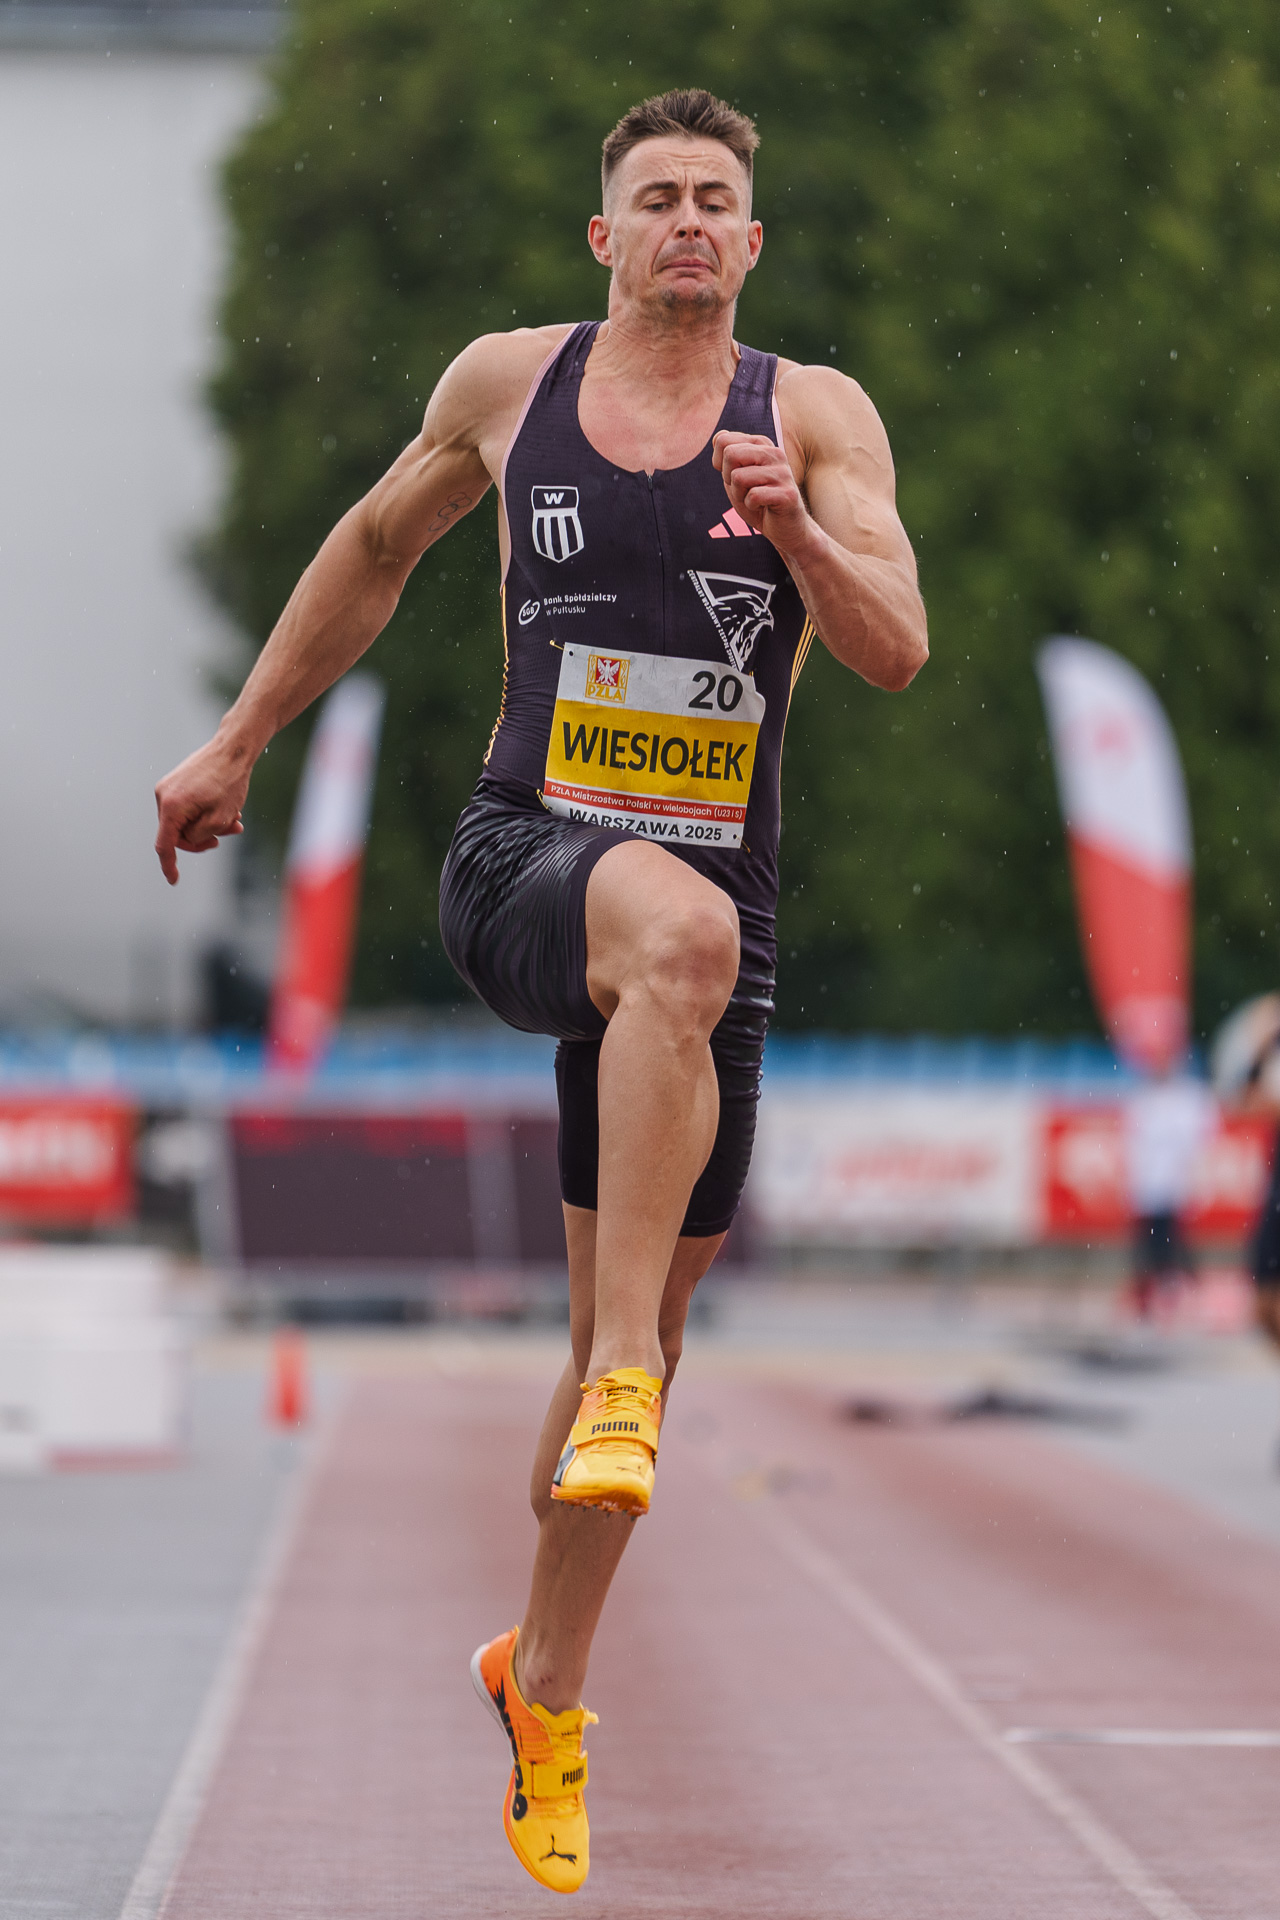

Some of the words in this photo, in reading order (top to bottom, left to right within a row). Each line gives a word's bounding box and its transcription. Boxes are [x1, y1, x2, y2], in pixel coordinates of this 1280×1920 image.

[543, 492, 565, 505] W
[543, 595, 562, 606] Bank
[564, 592, 617, 603] Spółdzielczy
[522, 606, 535, 617] SGB
[553, 605, 586, 615] Pułtusku
[587, 684, 623, 701] PZLA
[688, 670, 744, 712] 20
[562, 721, 748, 782] WIESIOŁEK
[551, 785, 570, 797] PZLA
[572, 790, 624, 807] Mistrzostwa
[626, 798, 652, 810] Polski
[653, 803, 661, 811] w
[662, 803, 712, 817] wielobojach
[714, 806, 730, 818] (U23
[569, 807, 680, 838] WARSZAWA
[684, 824, 723, 841] 2025
[591, 1420, 639, 1435] PUMA
